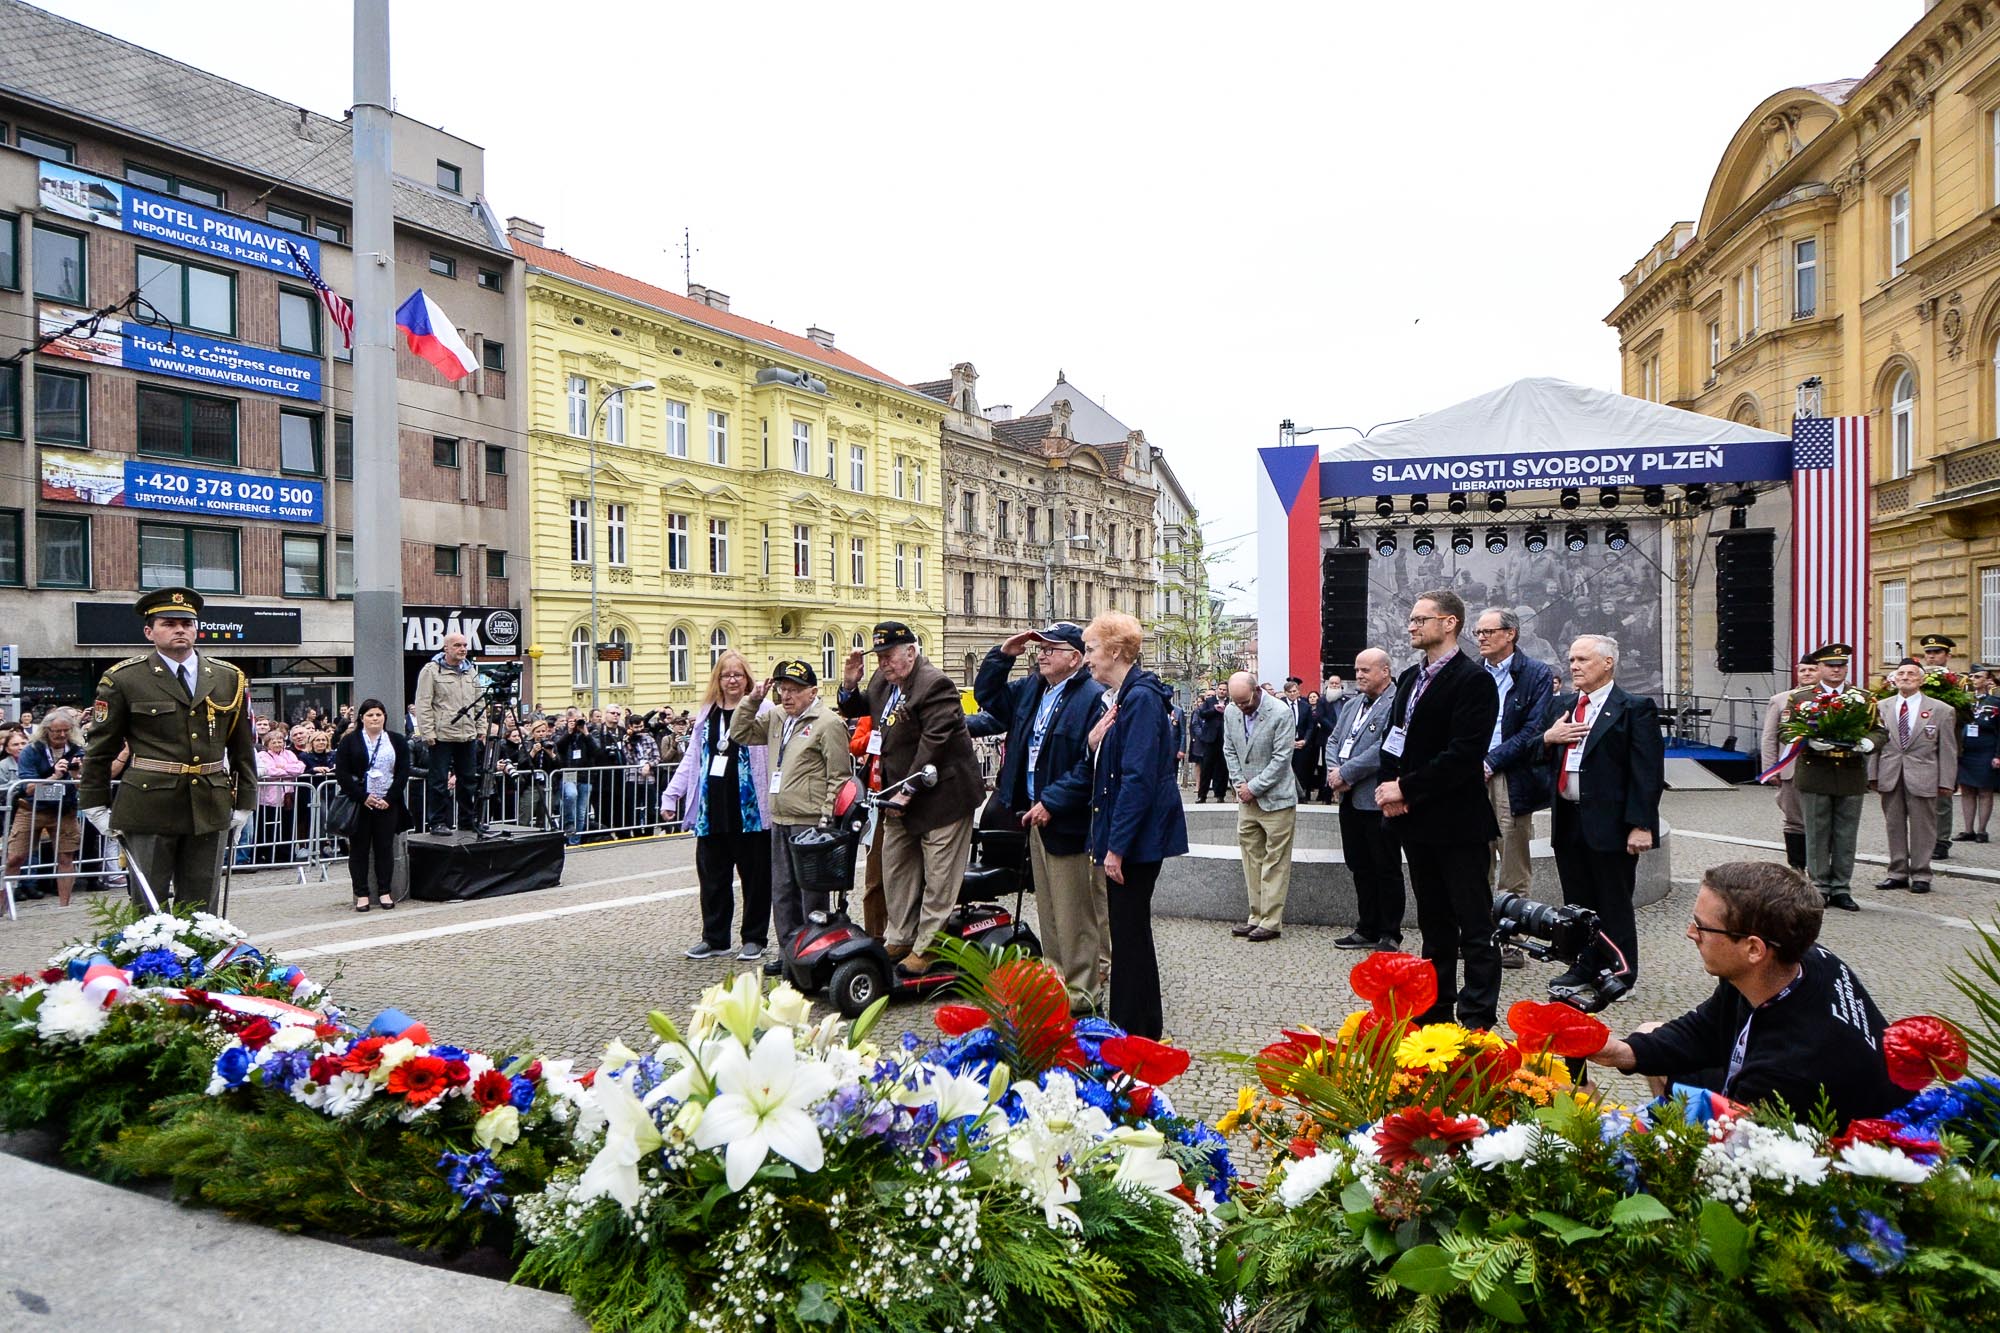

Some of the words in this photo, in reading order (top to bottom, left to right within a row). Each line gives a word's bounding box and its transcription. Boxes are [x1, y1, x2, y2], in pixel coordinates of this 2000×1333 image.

[133, 198, 198, 230] HOTEL
[133, 219, 208, 247] NEPOMUCKÁ
[210, 241, 233, 256] 128,
[235, 247, 268, 263] PLZEŇ
[287, 261, 294, 270] 4
[295, 262, 304, 273] k
[133, 335, 176, 355] Hotel
[181, 345, 195, 359] &
[199, 348, 265, 371] Congress
[268, 363, 311, 380] centre
[149, 357, 299, 393] WWW.PRIMAVERAHOTEL.CZ
[1371, 460, 1506, 483] SLAVNOSTI
[1512, 454, 1636, 476] SVOBODY
[1641, 445, 1724, 471] PLZEŇ
[134, 472, 189, 493] +420
[196, 478, 233, 497] 378
[238, 482, 274, 501] 020
[279, 487, 313, 504] 500
[1452, 478, 1525, 491] LIBERATION
[1527, 477, 1587, 489] FESTIVAL
[1589, 474, 1635, 485] PILSEN
[135, 492, 198, 507] UBYTOVÁNÍ
[206, 500, 271, 514] KONFERENCE
[278, 506, 313, 517] SVATBY
[200, 621, 244, 632] Potraviny
[492, 627, 513, 635] STRIKE
[494, 620, 513, 628] LUCKY
